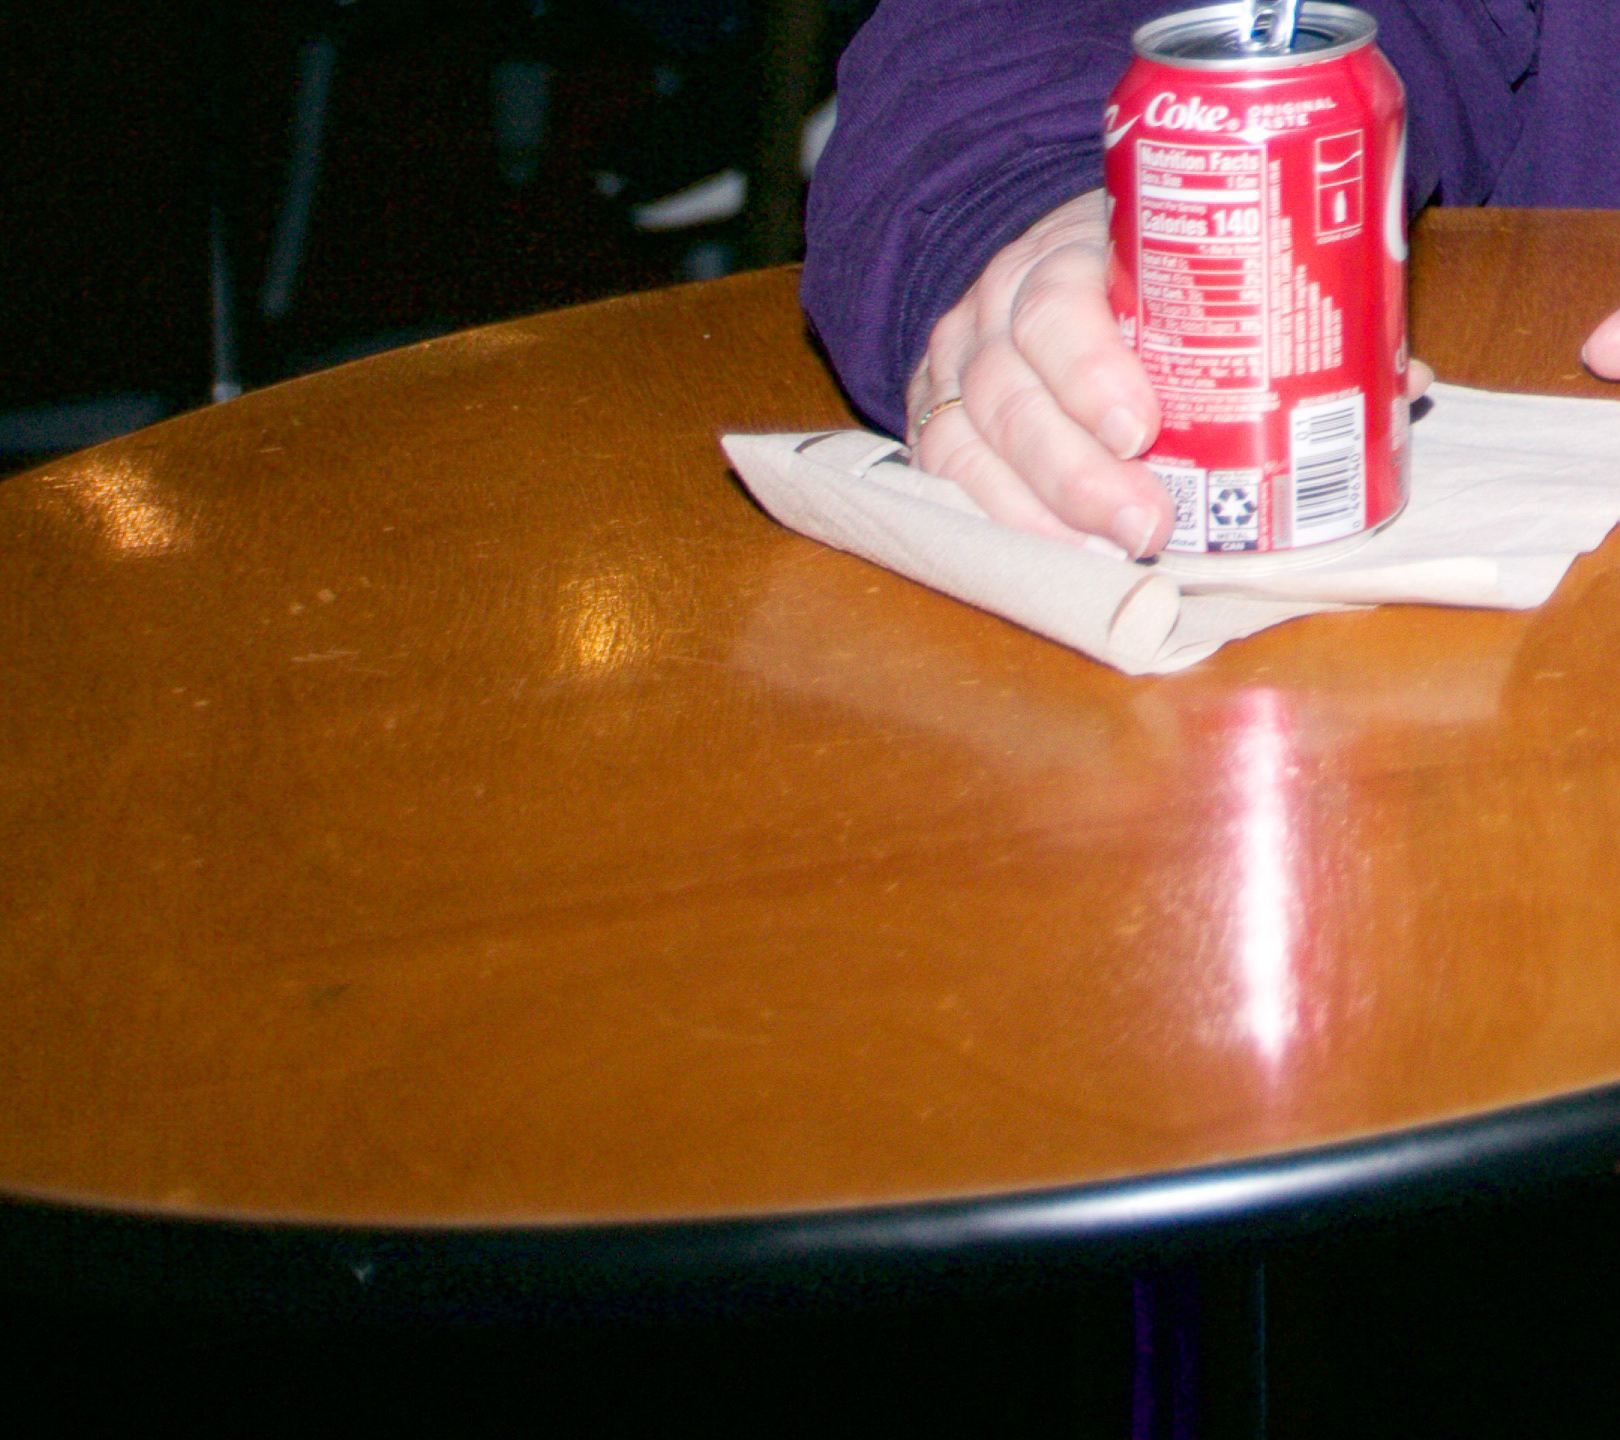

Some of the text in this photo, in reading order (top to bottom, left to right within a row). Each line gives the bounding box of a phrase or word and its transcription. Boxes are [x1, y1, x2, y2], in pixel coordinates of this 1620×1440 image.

[1145, 91, 1230, 132] Coke
[1246, 97, 1338, 118] ORIGINAL
[1142, 145, 1260, 171] Nutrition Facts
[1142, 207, 1259, 236] Calories 140
